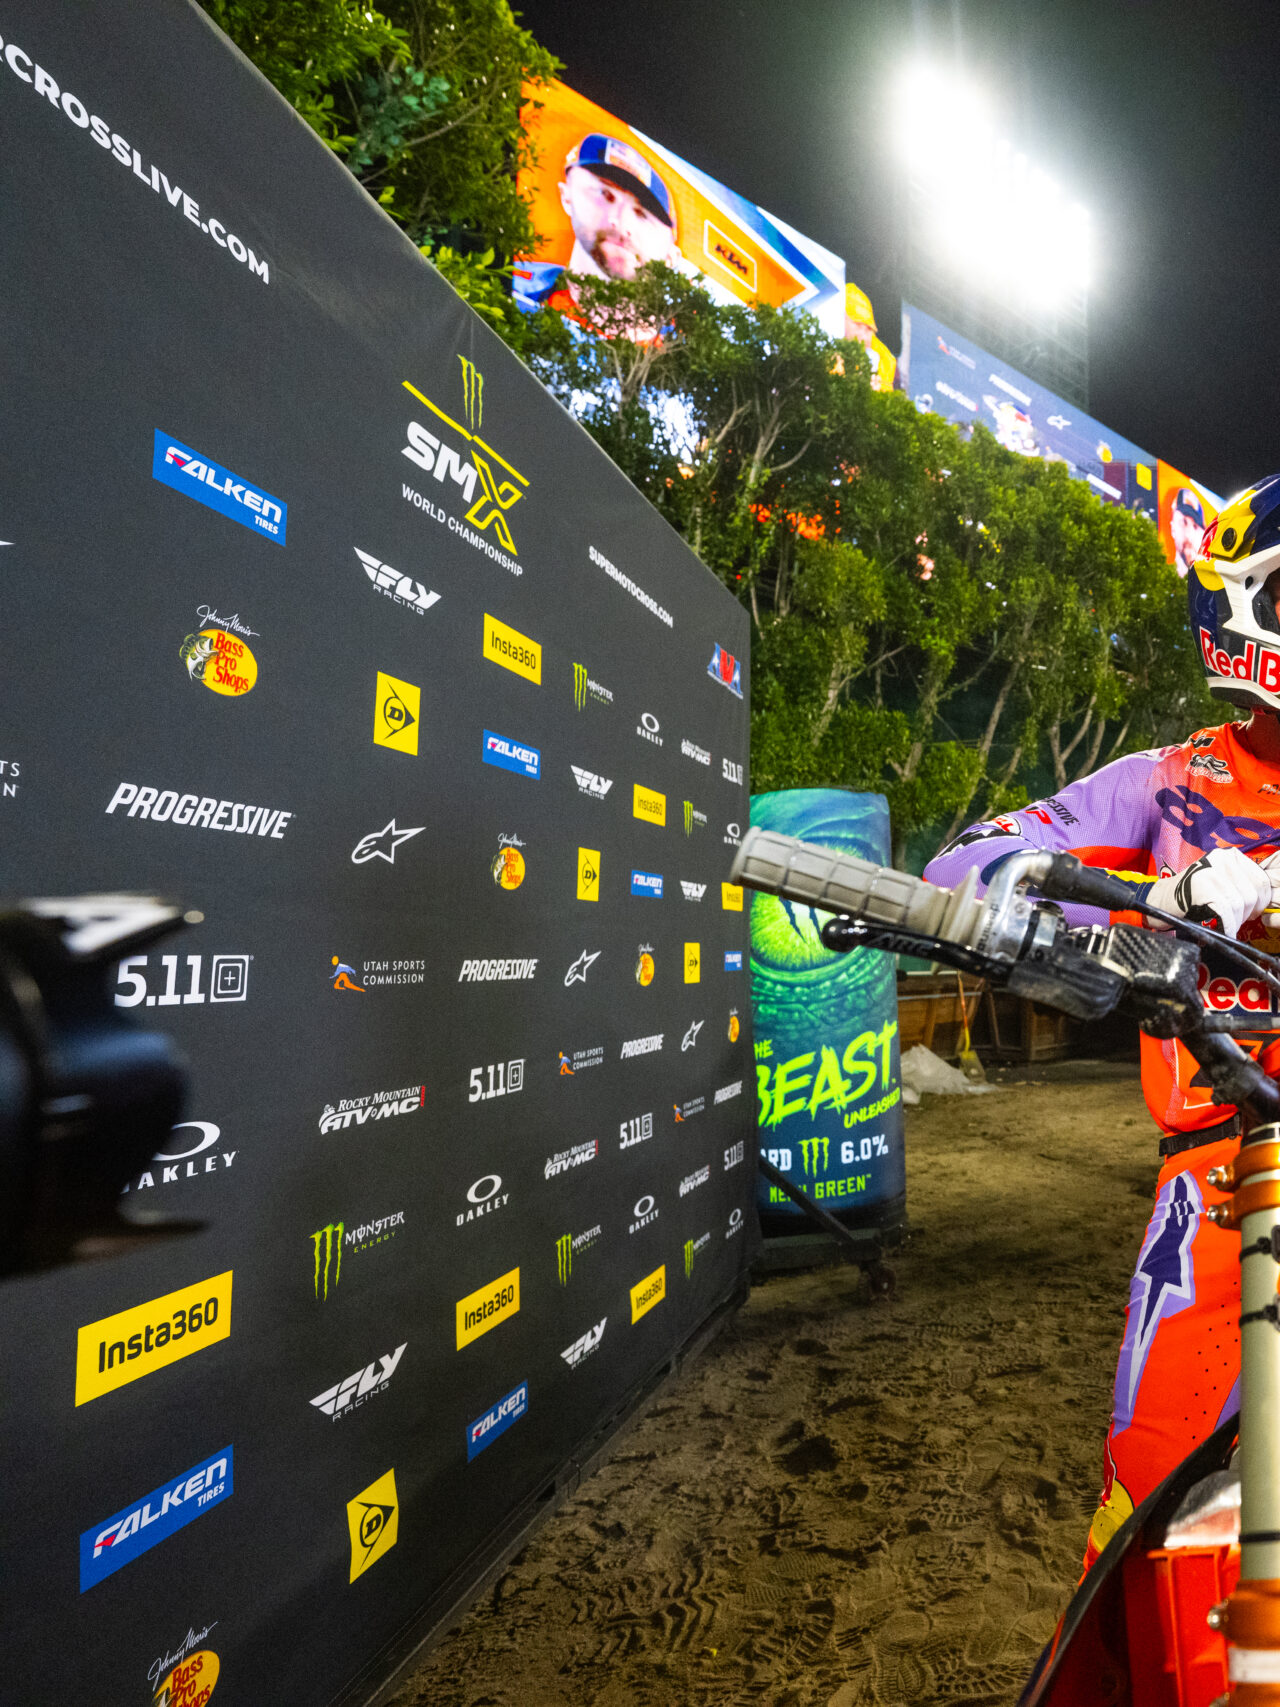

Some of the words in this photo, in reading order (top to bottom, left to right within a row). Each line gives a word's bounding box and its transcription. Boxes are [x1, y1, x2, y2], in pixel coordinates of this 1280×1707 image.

[0, 34, 270, 285] CROSSLIVE.COM
[715, 243, 748, 275] KTM
[165, 446, 283, 523] FALKEN
[401, 421, 523, 556] SMX
[254, 515, 279, 535] TIRES
[402, 483, 446, 524] WORLD
[448, 516, 523, 577] CHAMPIONSHIP
[372, 583, 425, 616] RACING
[589, 545, 674, 628] SUPERMOTOCROSS.COM
[214, 649, 237, 671] Pro
[215, 632, 244, 658] Bass
[491, 631, 536, 671] Insta360
[212, 665, 249, 693] Shops
[487, 736, 539, 767] FALKEN
[105, 781, 292, 839] PROGRESSIVE
[114, 954, 206, 1008] 5.11
[363, 961, 389, 971] UTAH
[393, 959, 425, 971] SPORTS
[363, 973, 424, 986] COMMISSION
[458, 958, 539, 982] PROGRESSIVE
[754, 1040, 773, 1060] HE
[338, 1096, 371, 1113] ROCKY
[373, 1085, 421, 1106] MOUNTAIN
[468, 1063, 506, 1103] 5.11
[844, 1087, 901, 1129] UNLEASHED
[620, 1117, 642, 1149] 5.11
[840, 1133, 889, 1164] 6.0%
[120, 1150, 237, 1194] AKLEY
[814, 1174, 867, 1199] GREEN
[456, 1193, 510, 1227] OAKLEY
[629, 1208, 660, 1235] OAKLEY
[345, 1211, 405, 1246] MONSTER
[353, 1231, 397, 1254] ENERGY
[464, 1285, 514, 1331] Insta360
[636, 1277, 663, 1311] Insta360
[98, 1296, 219, 1374] Insta360
[332, 1380, 390, 1422] RACING
[471, 1386, 526, 1443] FALKEN
[93, 1457, 228, 1559] FALKEN
[197, 1481, 225, 1508] TIRES
[171, 1655, 204, 1695] Bass
[176, 1679, 197, 1704] Pro
